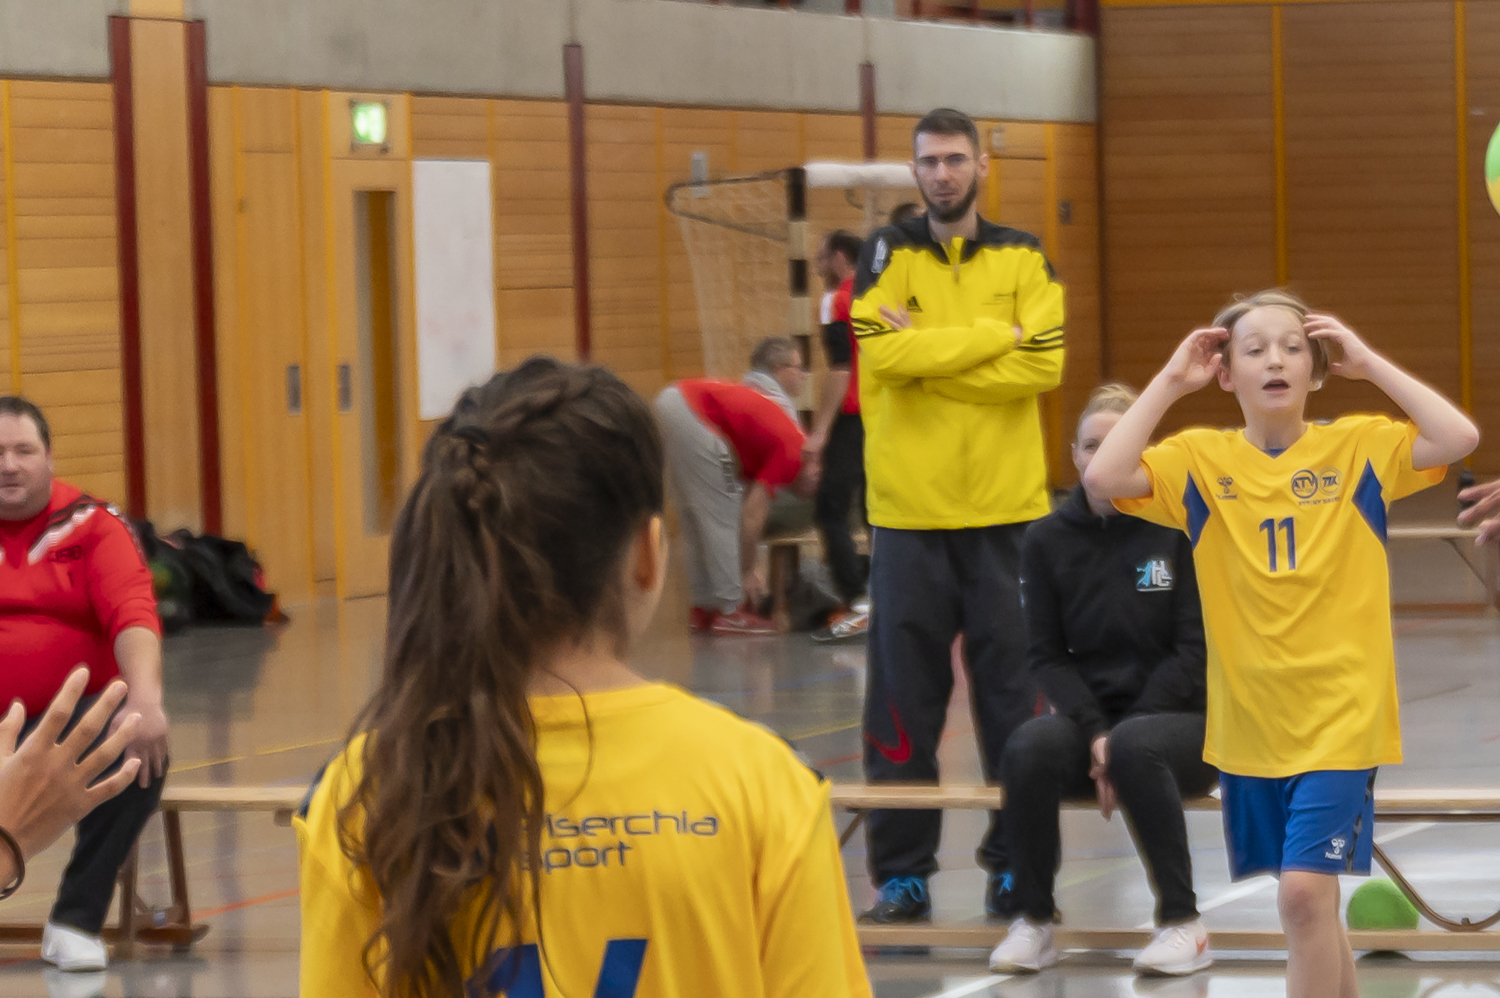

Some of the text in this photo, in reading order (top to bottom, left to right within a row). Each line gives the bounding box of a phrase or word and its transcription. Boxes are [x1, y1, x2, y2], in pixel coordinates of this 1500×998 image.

[1259, 517, 1296, 572] 11
[543, 811, 719, 838] iserchia
[522, 841, 632, 875] port
